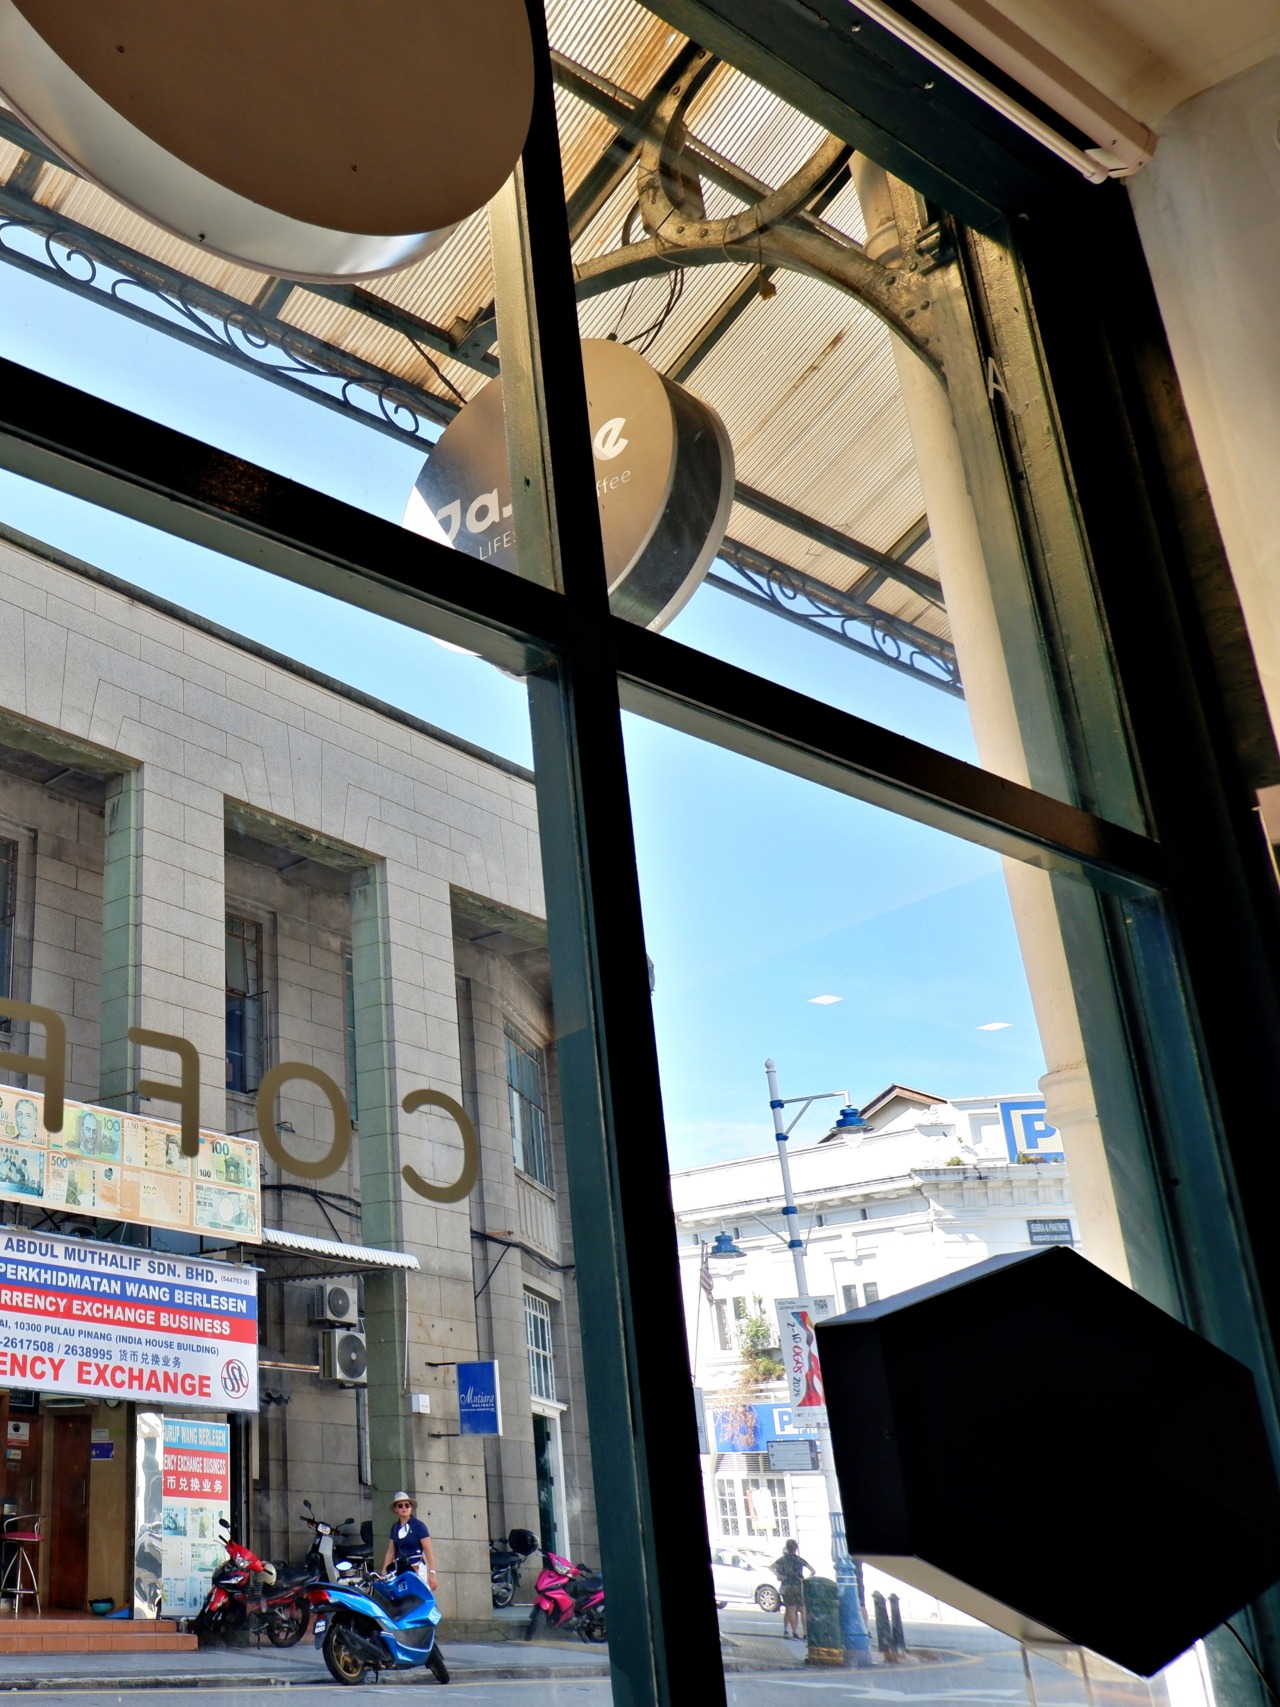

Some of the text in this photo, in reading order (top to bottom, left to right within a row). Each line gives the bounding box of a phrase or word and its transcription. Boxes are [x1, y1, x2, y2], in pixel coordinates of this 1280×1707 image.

[209, 1140, 230, 1156] 100
[4, 1237, 59, 1259] ABDUL
[64, 1246, 141, 1271] MUTHALIF
[147, 1260, 181, 1278] SDN.
[185, 1266, 218, 1284] BHD.
[125, 1282, 170, 1302] WANG
[174, 1289, 247, 1313] BERLESEN
[72, 1299, 155, 1325] EXCHANGE
[160, 1314, 231, 1336] BUSINESS
[14, 1320, 42, 1333] 10300
[44, 1325, 76, 1337] PULAU
[78, 1330, 112, 1342] PINANG
[115, 1334, 143, 1347] (INDIA
[145, 1338, 175, 1350] HOUSE
[177, 1342, 220, 1356] BUILDING)
[64, 1343, 113, 1361] 2638995
[118, 1349, 182, 1369] 货币兑换业务
[76, 1360, 212, 1398] EXCHANGE
[792, 1376, 801, 1398] 2025
[163, 1425, 226, 1448] URUP WANG BERLESEN
[163, 1454, 226, 1476] ENCY EXCHANGE BUSINESS
[163, 1475, 224, 1494] 币兑换业务
